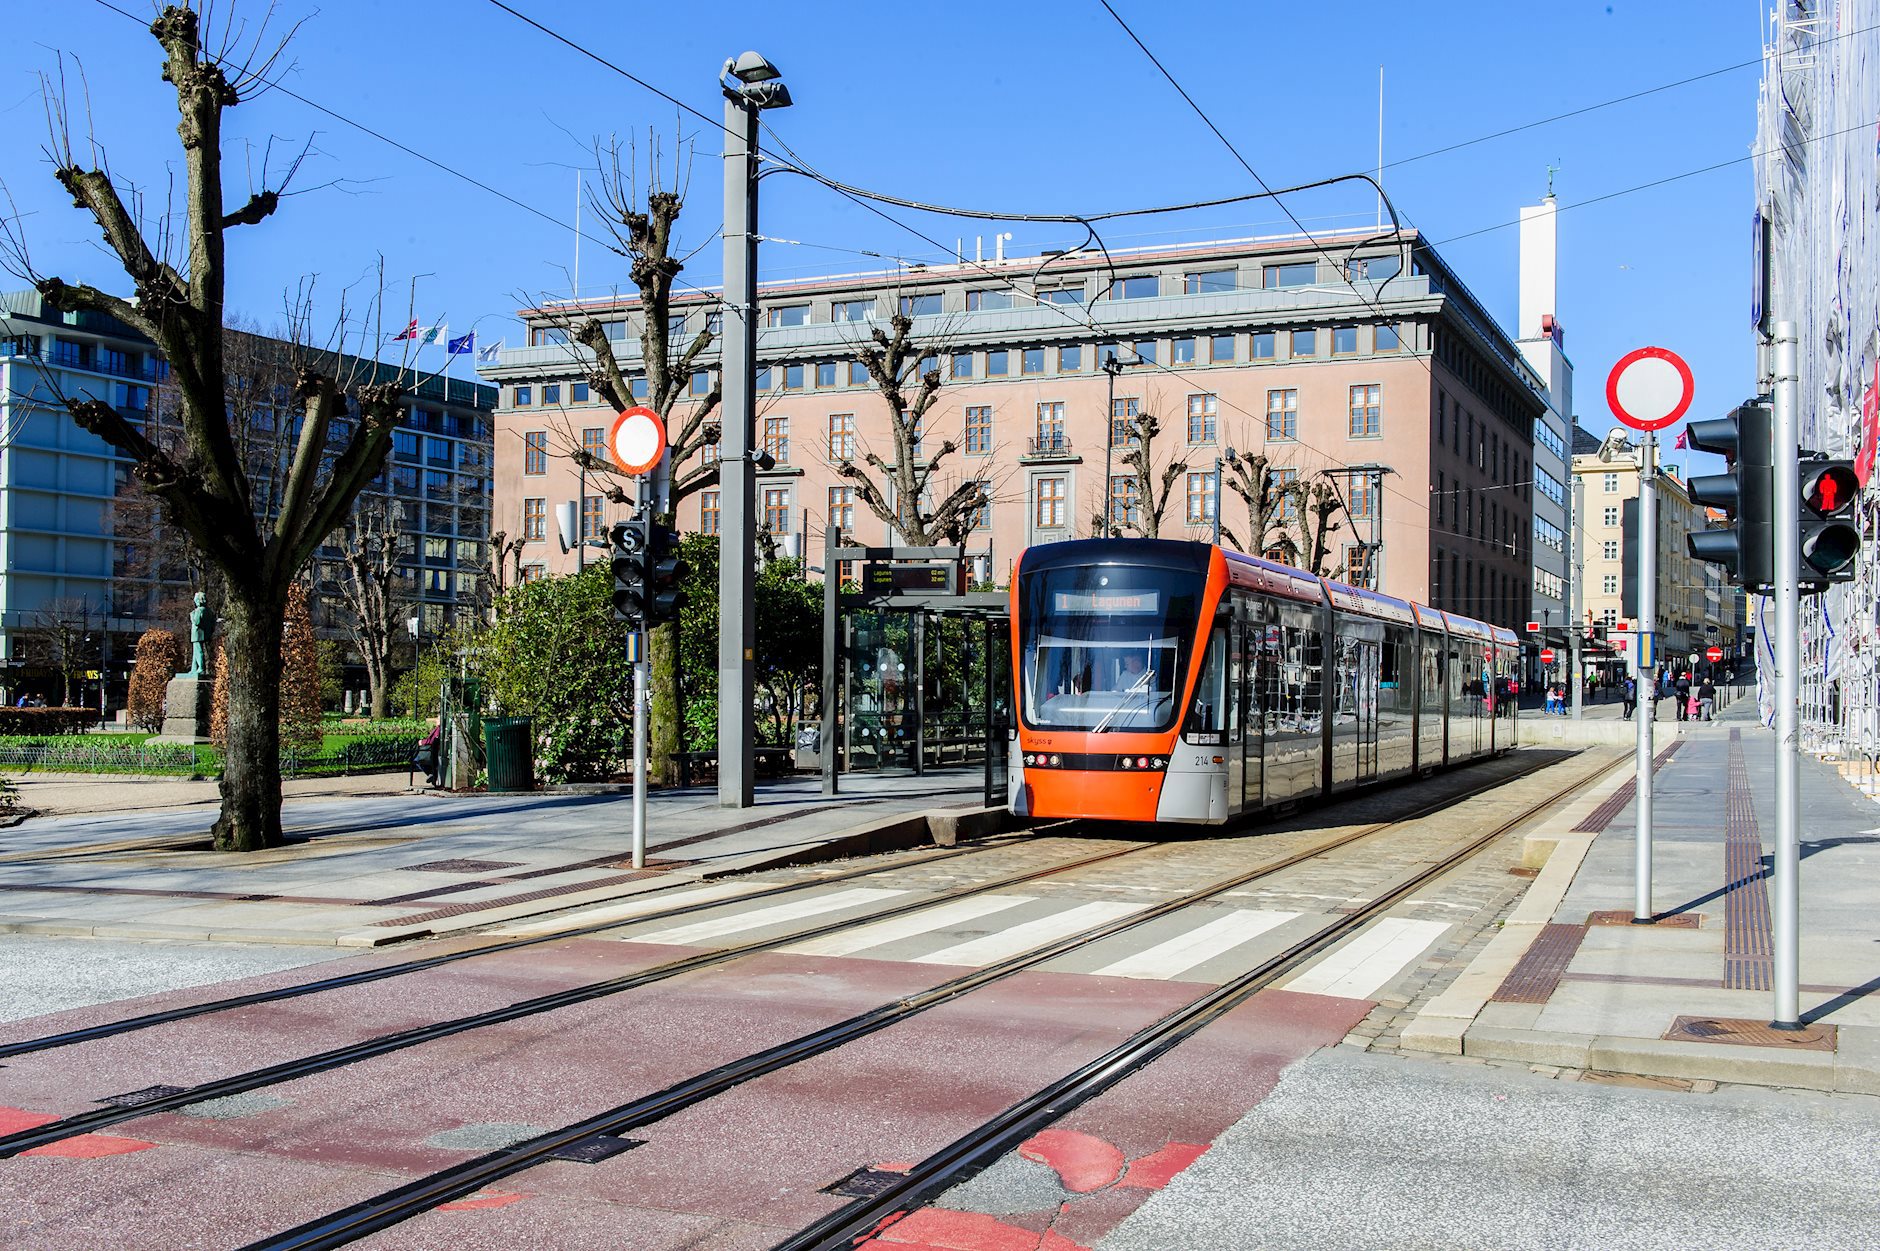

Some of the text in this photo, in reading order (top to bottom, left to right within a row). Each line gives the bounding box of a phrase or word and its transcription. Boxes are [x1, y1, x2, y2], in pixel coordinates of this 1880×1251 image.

[623, 529, 636, 550] S
[1062, 592, 1141, 610] 1 Lagunen
[1027, 737, 1047, 745] skyss
[1195, 756, 1209, 766] 214
